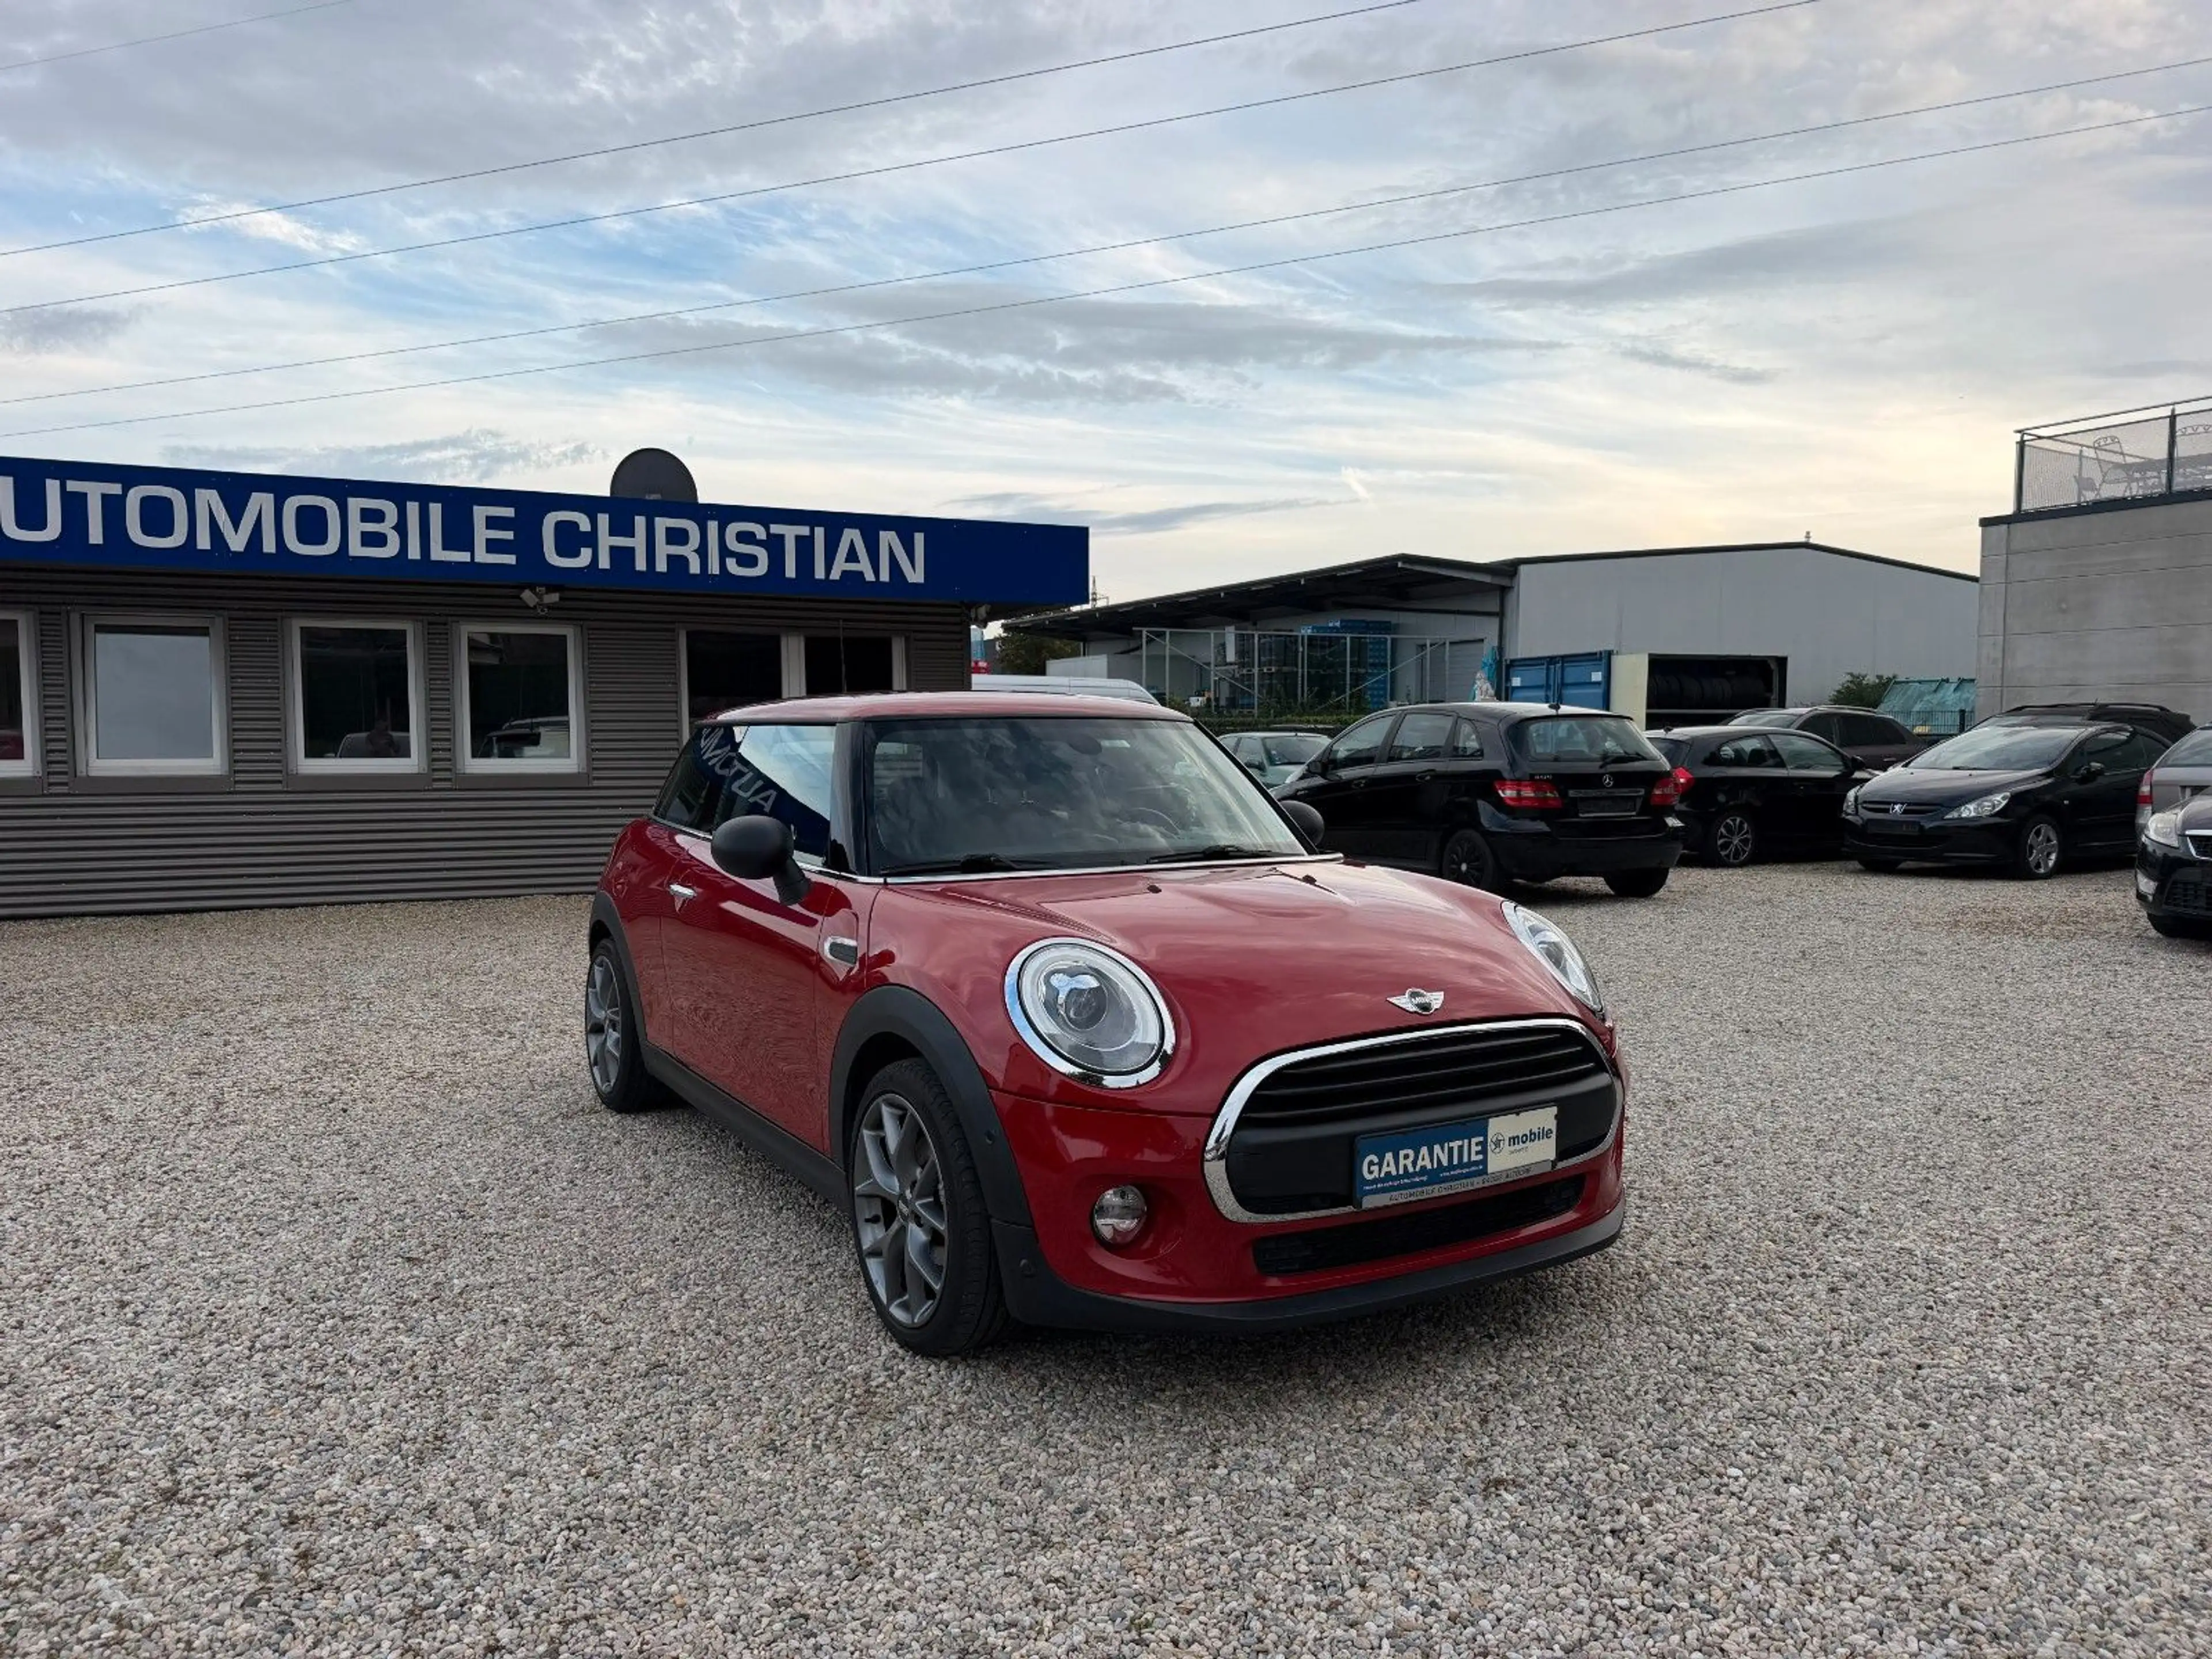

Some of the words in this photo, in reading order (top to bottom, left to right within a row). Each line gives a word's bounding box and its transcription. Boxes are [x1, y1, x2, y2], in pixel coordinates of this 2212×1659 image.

[541, 510, 925, 584] CHRISTIAN
[1362, 1136, 1484, 1180] GARANTIE
[1508, 1126, 1554, 1147] mobile
